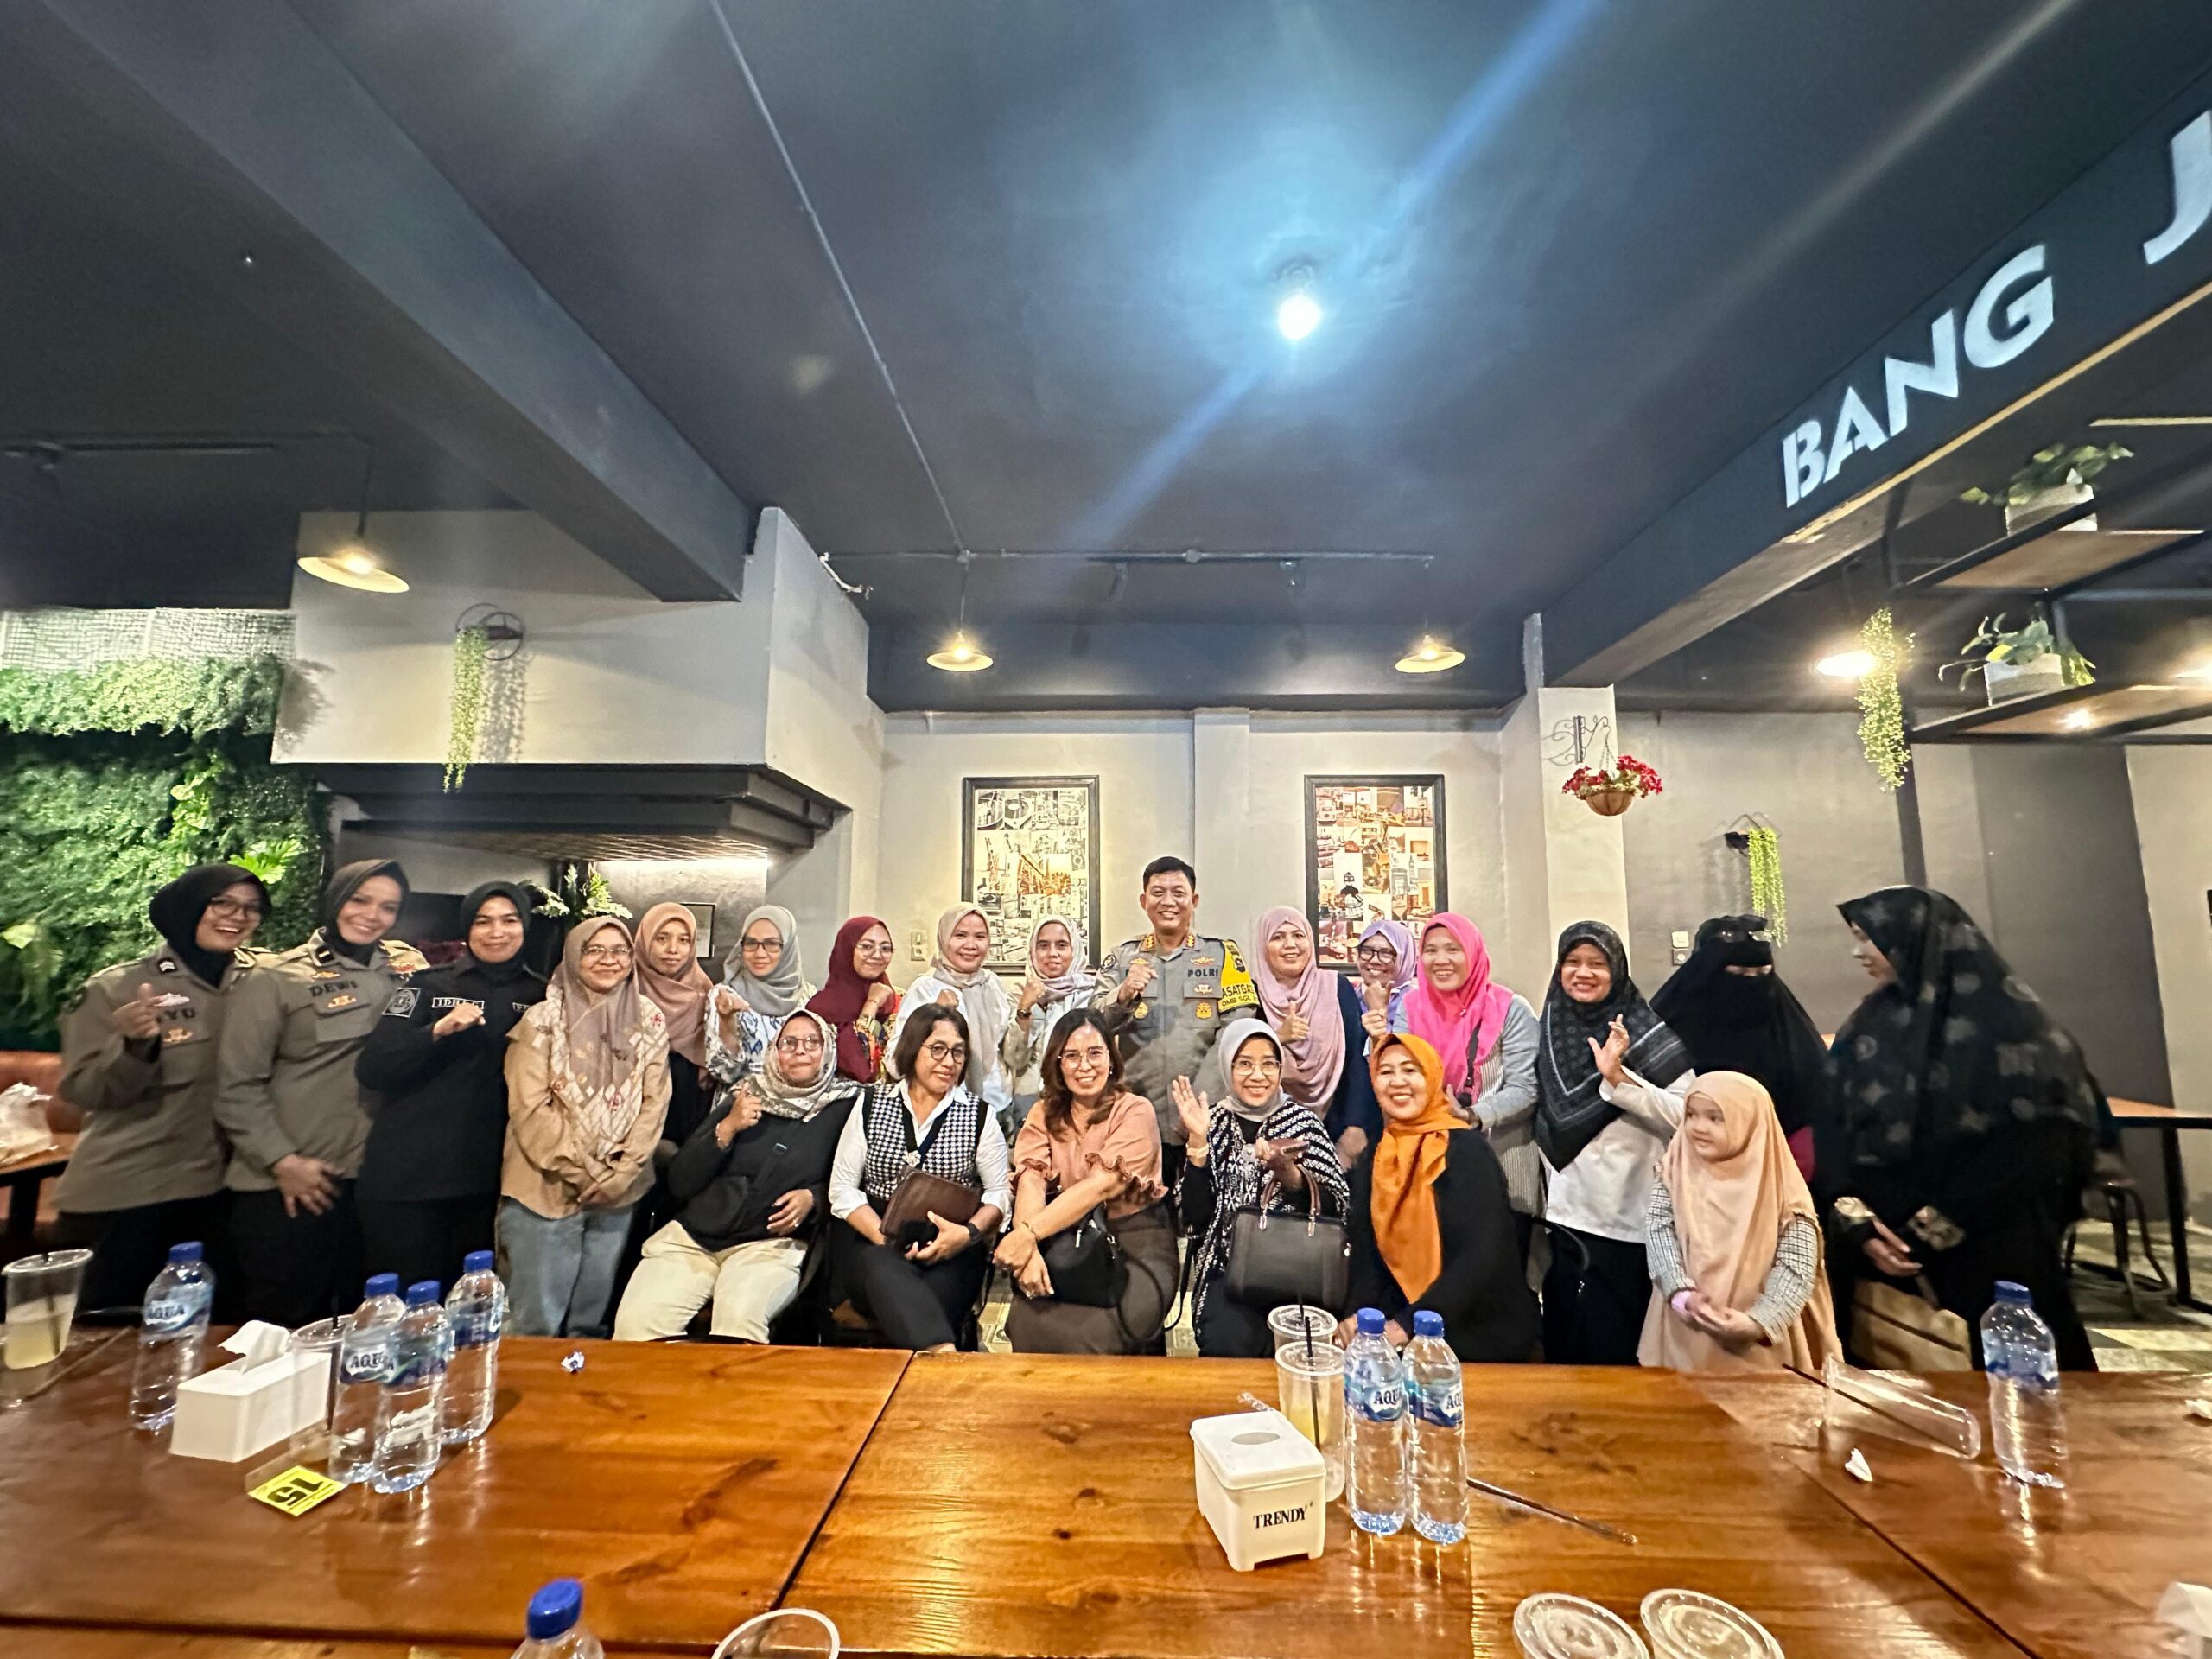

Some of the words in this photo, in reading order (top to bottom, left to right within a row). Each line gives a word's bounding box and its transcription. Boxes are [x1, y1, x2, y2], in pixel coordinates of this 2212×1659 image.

[1783, 244, 2054, 508] BANG
[1187, 968, 1219, 978] POLRI
[267, 1478, 324, 1506] 15
[1253, 1504, 1308, 1529] TRENDY
